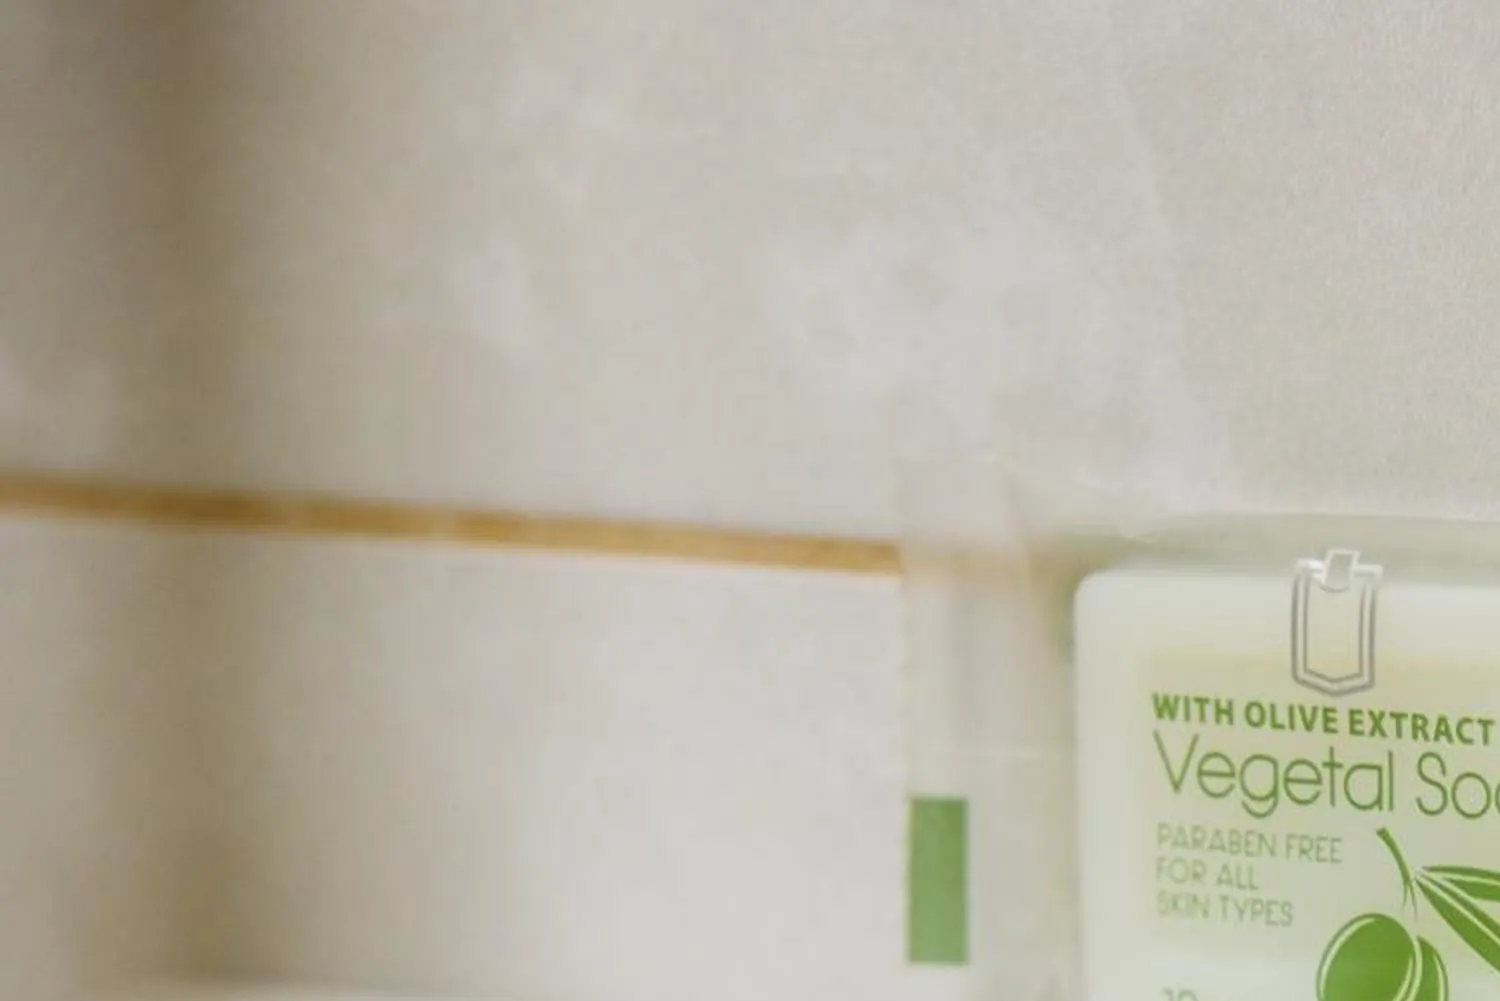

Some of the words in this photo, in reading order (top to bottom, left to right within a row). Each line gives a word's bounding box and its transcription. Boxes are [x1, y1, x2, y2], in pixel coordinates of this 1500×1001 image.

[1152, 694, 1235, 726] WITH
[1244, 700, 1339, 735] OLIVE
[1348, 708, 1495, 746] EXTRACT
[1152, 730, 1395, 819] Vegetal
[1157, 821, 1278, 858] PARABEN
[1285, 832, 1344, 865] FREE
[1156, 855, 1207, 885] FOR
[1216, 863, 1260, 891] ALL
[1157, 889, 1210, 920] SKIN
[1218, 894, 1294, 928] TYPES
